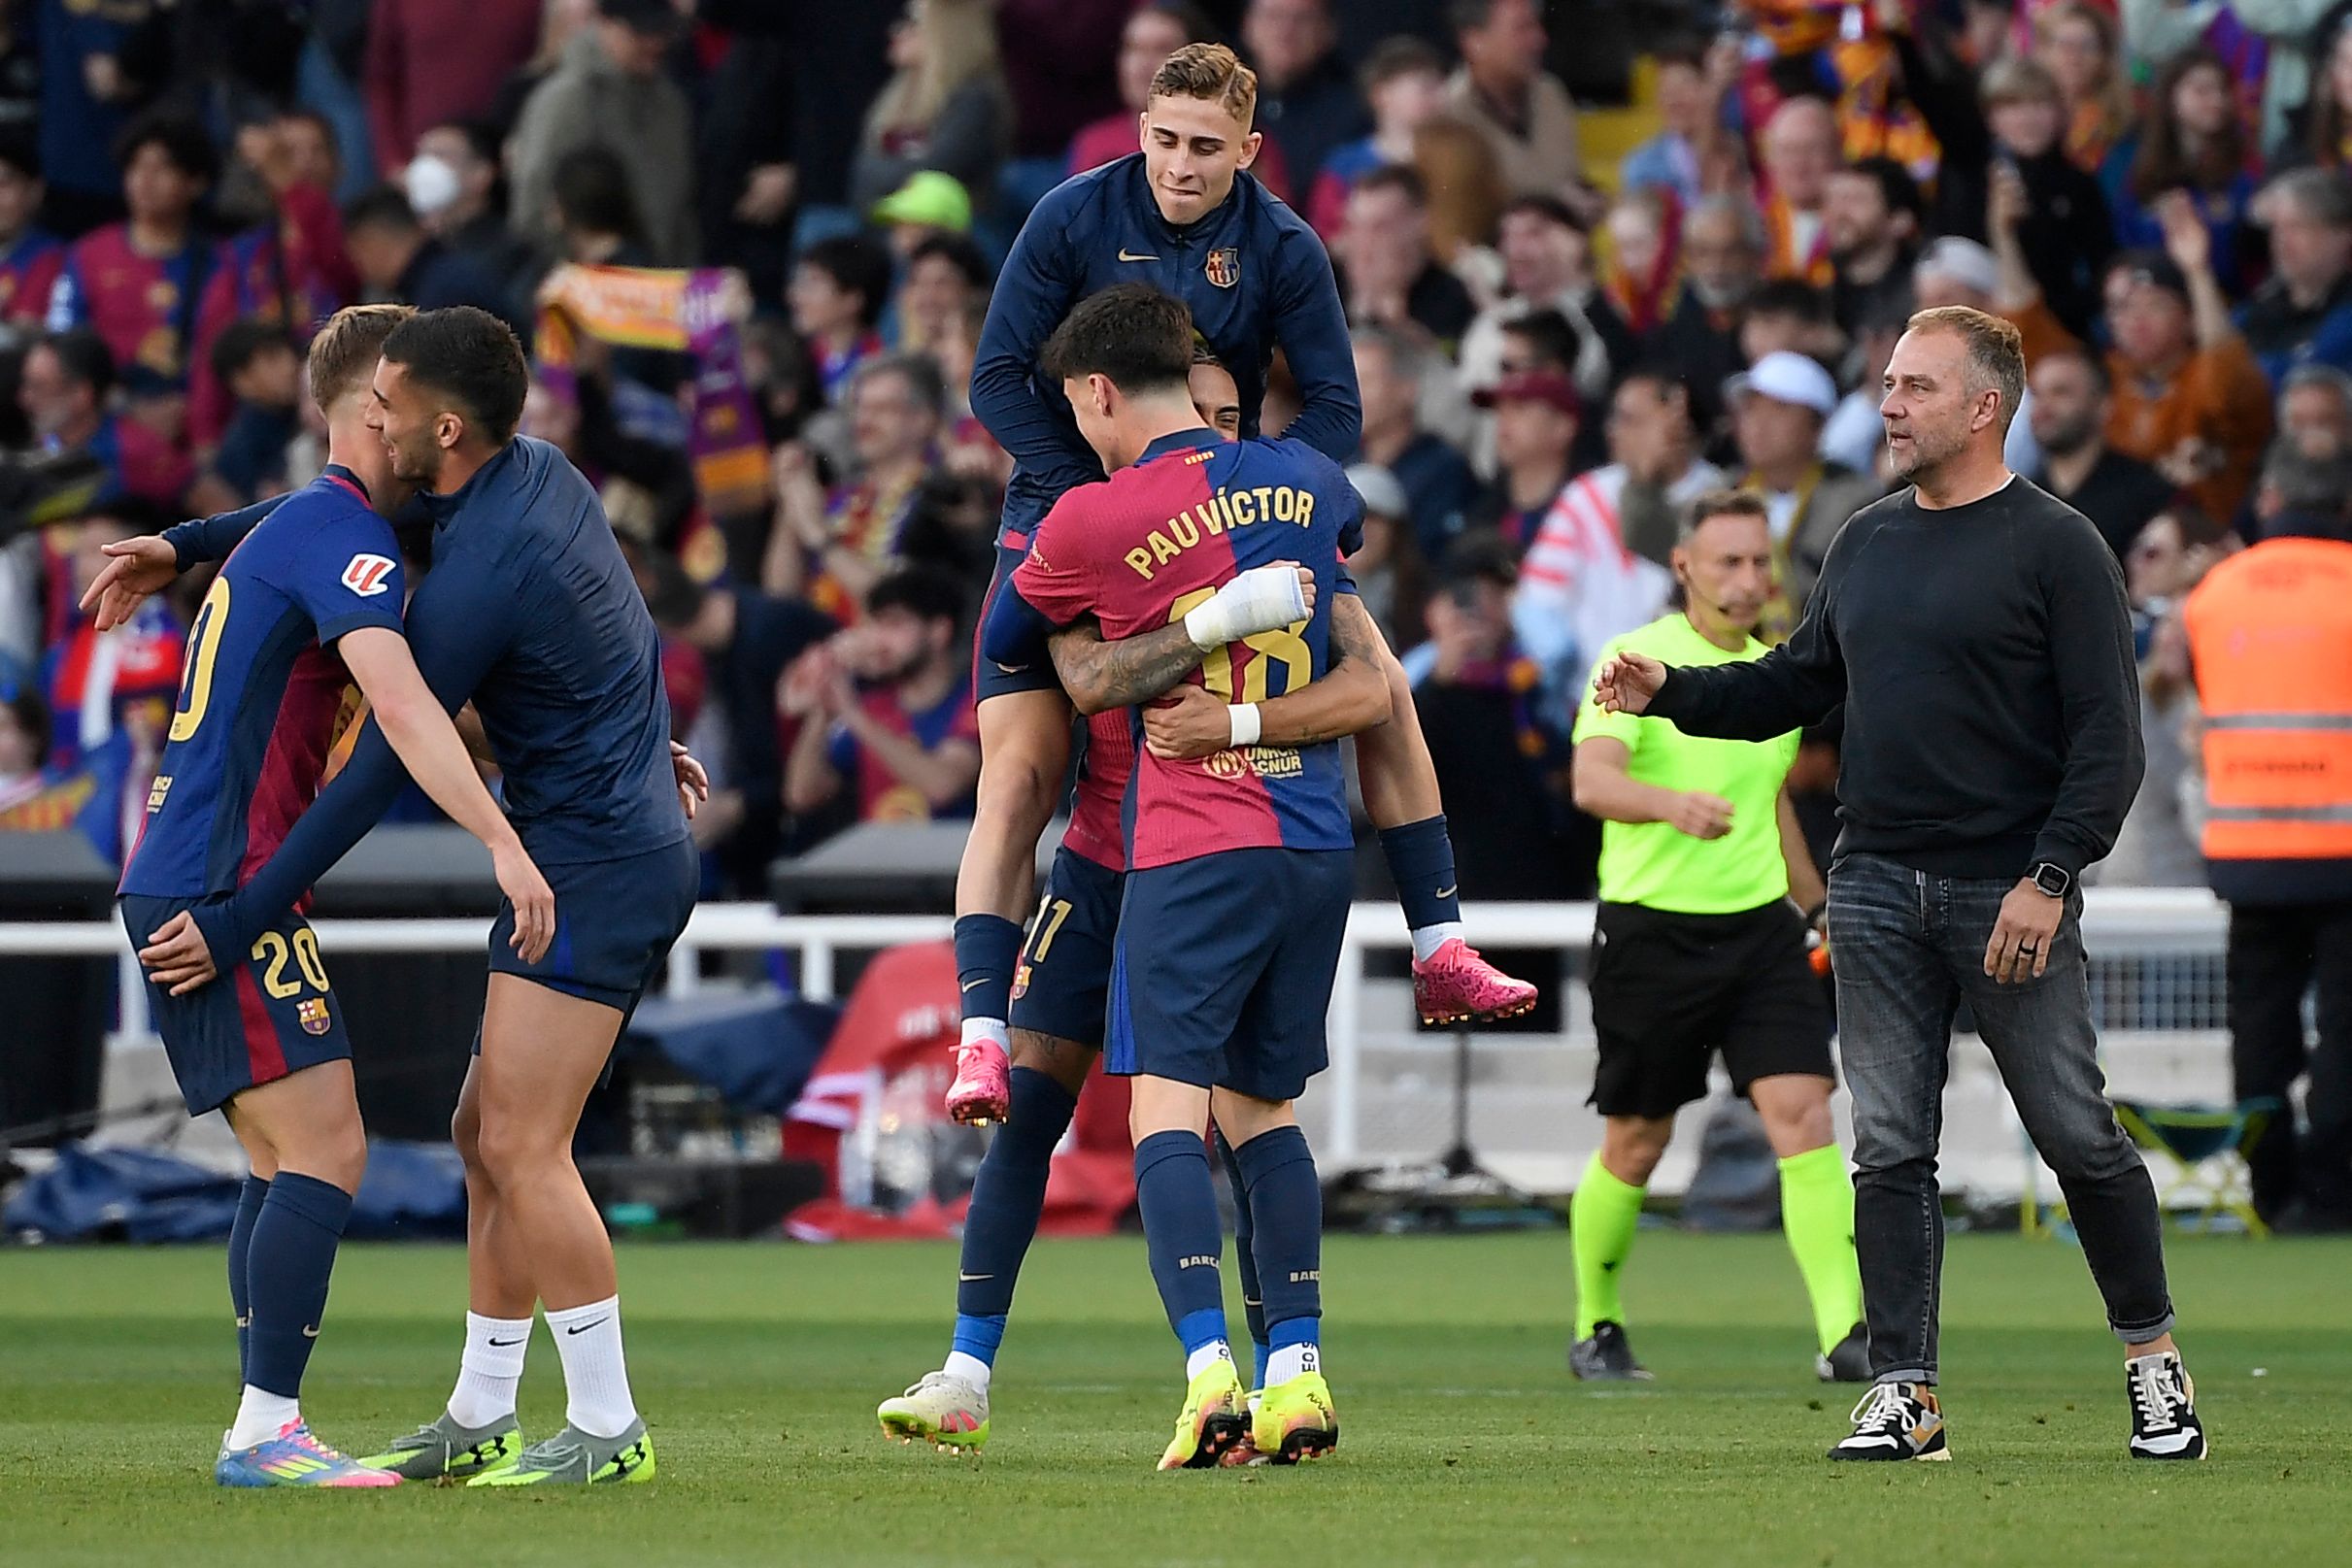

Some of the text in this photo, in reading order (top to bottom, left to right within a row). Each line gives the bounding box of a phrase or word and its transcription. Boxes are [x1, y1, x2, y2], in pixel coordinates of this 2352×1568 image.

[1124, 511, 1201, 581] PAU
[1195, 485, 1315, 536] VÍCTOR
[251, 927, 330, 1000] 20
